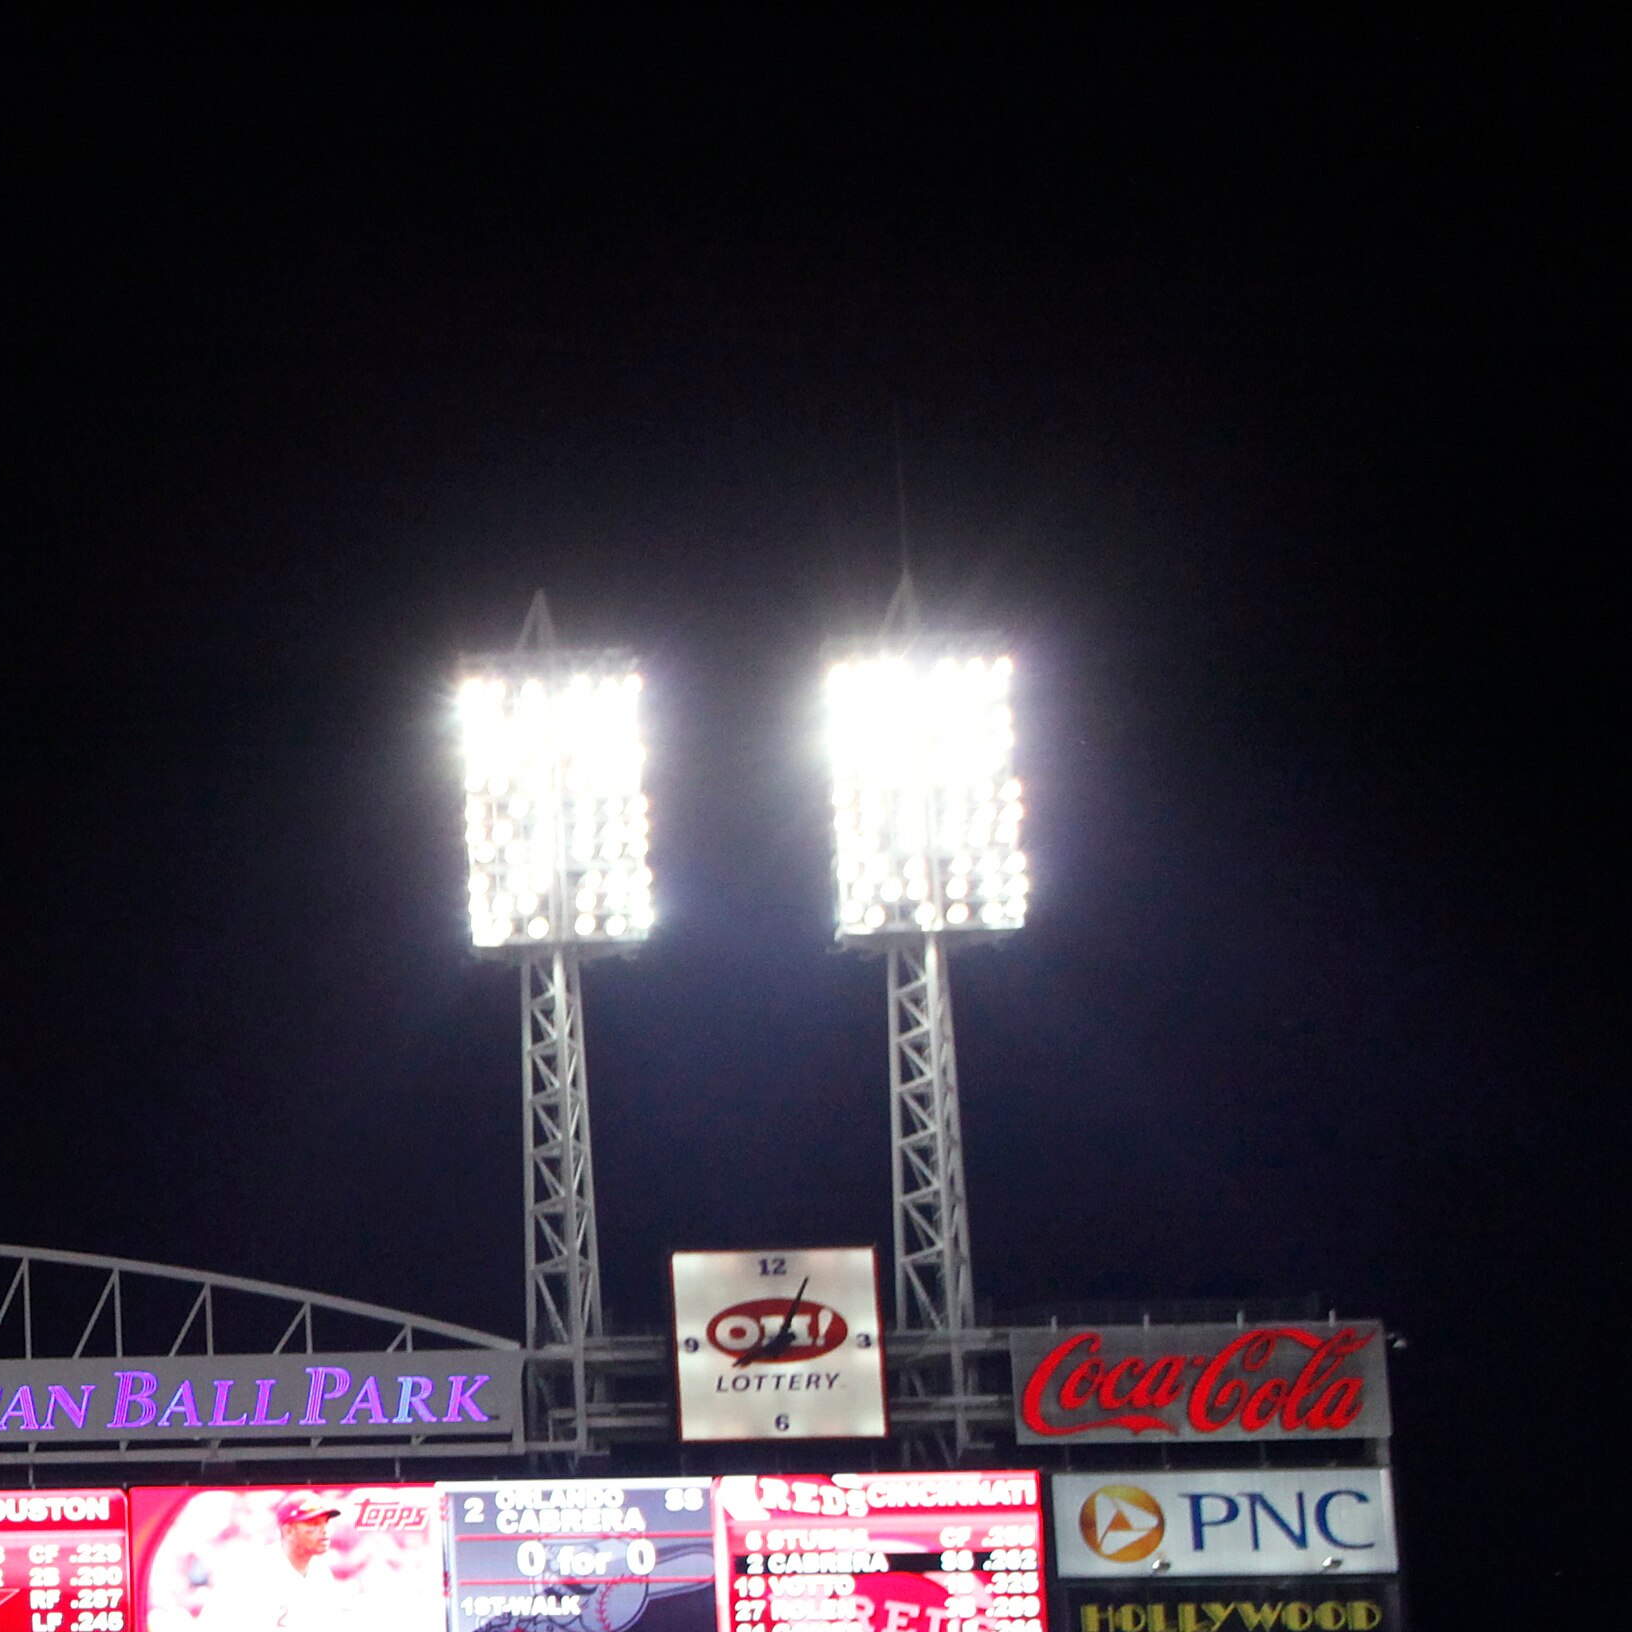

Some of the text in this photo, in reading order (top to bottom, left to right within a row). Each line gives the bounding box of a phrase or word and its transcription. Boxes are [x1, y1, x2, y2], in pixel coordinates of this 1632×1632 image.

[758, 1258, 787, 1276] 12
[684, 1337, 700, 1353] 9
[856, 1333, 873, 1349] 3
[715, 1373, 840, 1392] LOTTERY
[1021, 1328, 1377, 1436] Coca-Cola
[106, 1370, 292, 1429] BALL
[298, 1366, 492, 1426] PARK
[774, 1414, 790, 1432] 6
[494, 1487, 703, 1511] ORLANDO SS
[867, 1479, 1037, 1507] CINCINNATI
[464, 1497, 484, 1523] 2
[496, 1507, 647, 1532] CABRERA
[1178, 1489, 1376, 1554] PNC
[516, 1538, 656, 1577] 0 for 0
[768, 1551, 888, 1573] CABRERA
[769, 1574, 855, 1597] VOTTO
